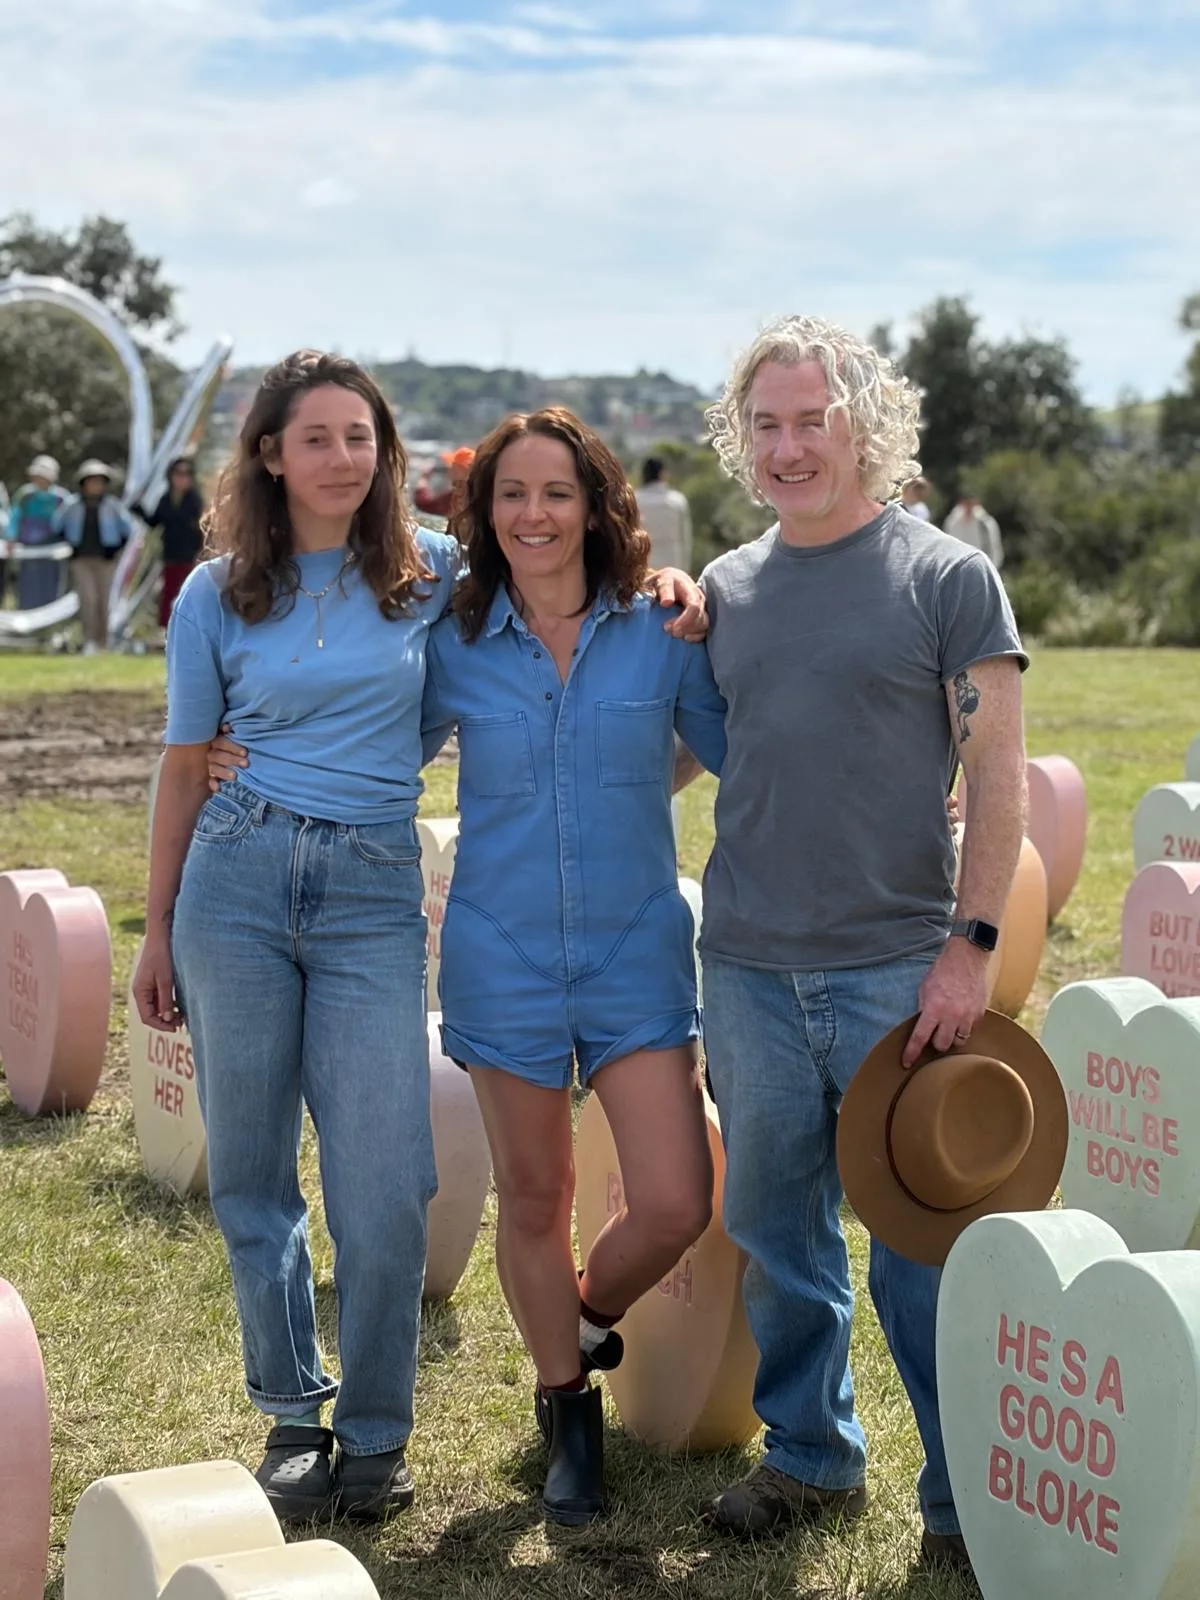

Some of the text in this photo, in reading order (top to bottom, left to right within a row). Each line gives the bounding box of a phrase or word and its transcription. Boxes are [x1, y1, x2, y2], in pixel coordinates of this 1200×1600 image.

[1163, 834, 1200, 859] 2 W
[1150, 911, 1193, 942] BUT
[148, 1031, 196, 1080] LOVES
[1087, 1051, 1161, 1104] BOYS
[155, 1074, 184, 1118] HER
[1069, 1090, 1179, 1156] WILL BE
[1087, 1140, 1161, 1197] BOYS
[1095, 1355, 1126, 1415] A
[998, 1383, 1117, 1478] GOOD
[988, 1444, 1121, 1555] BLOKE
